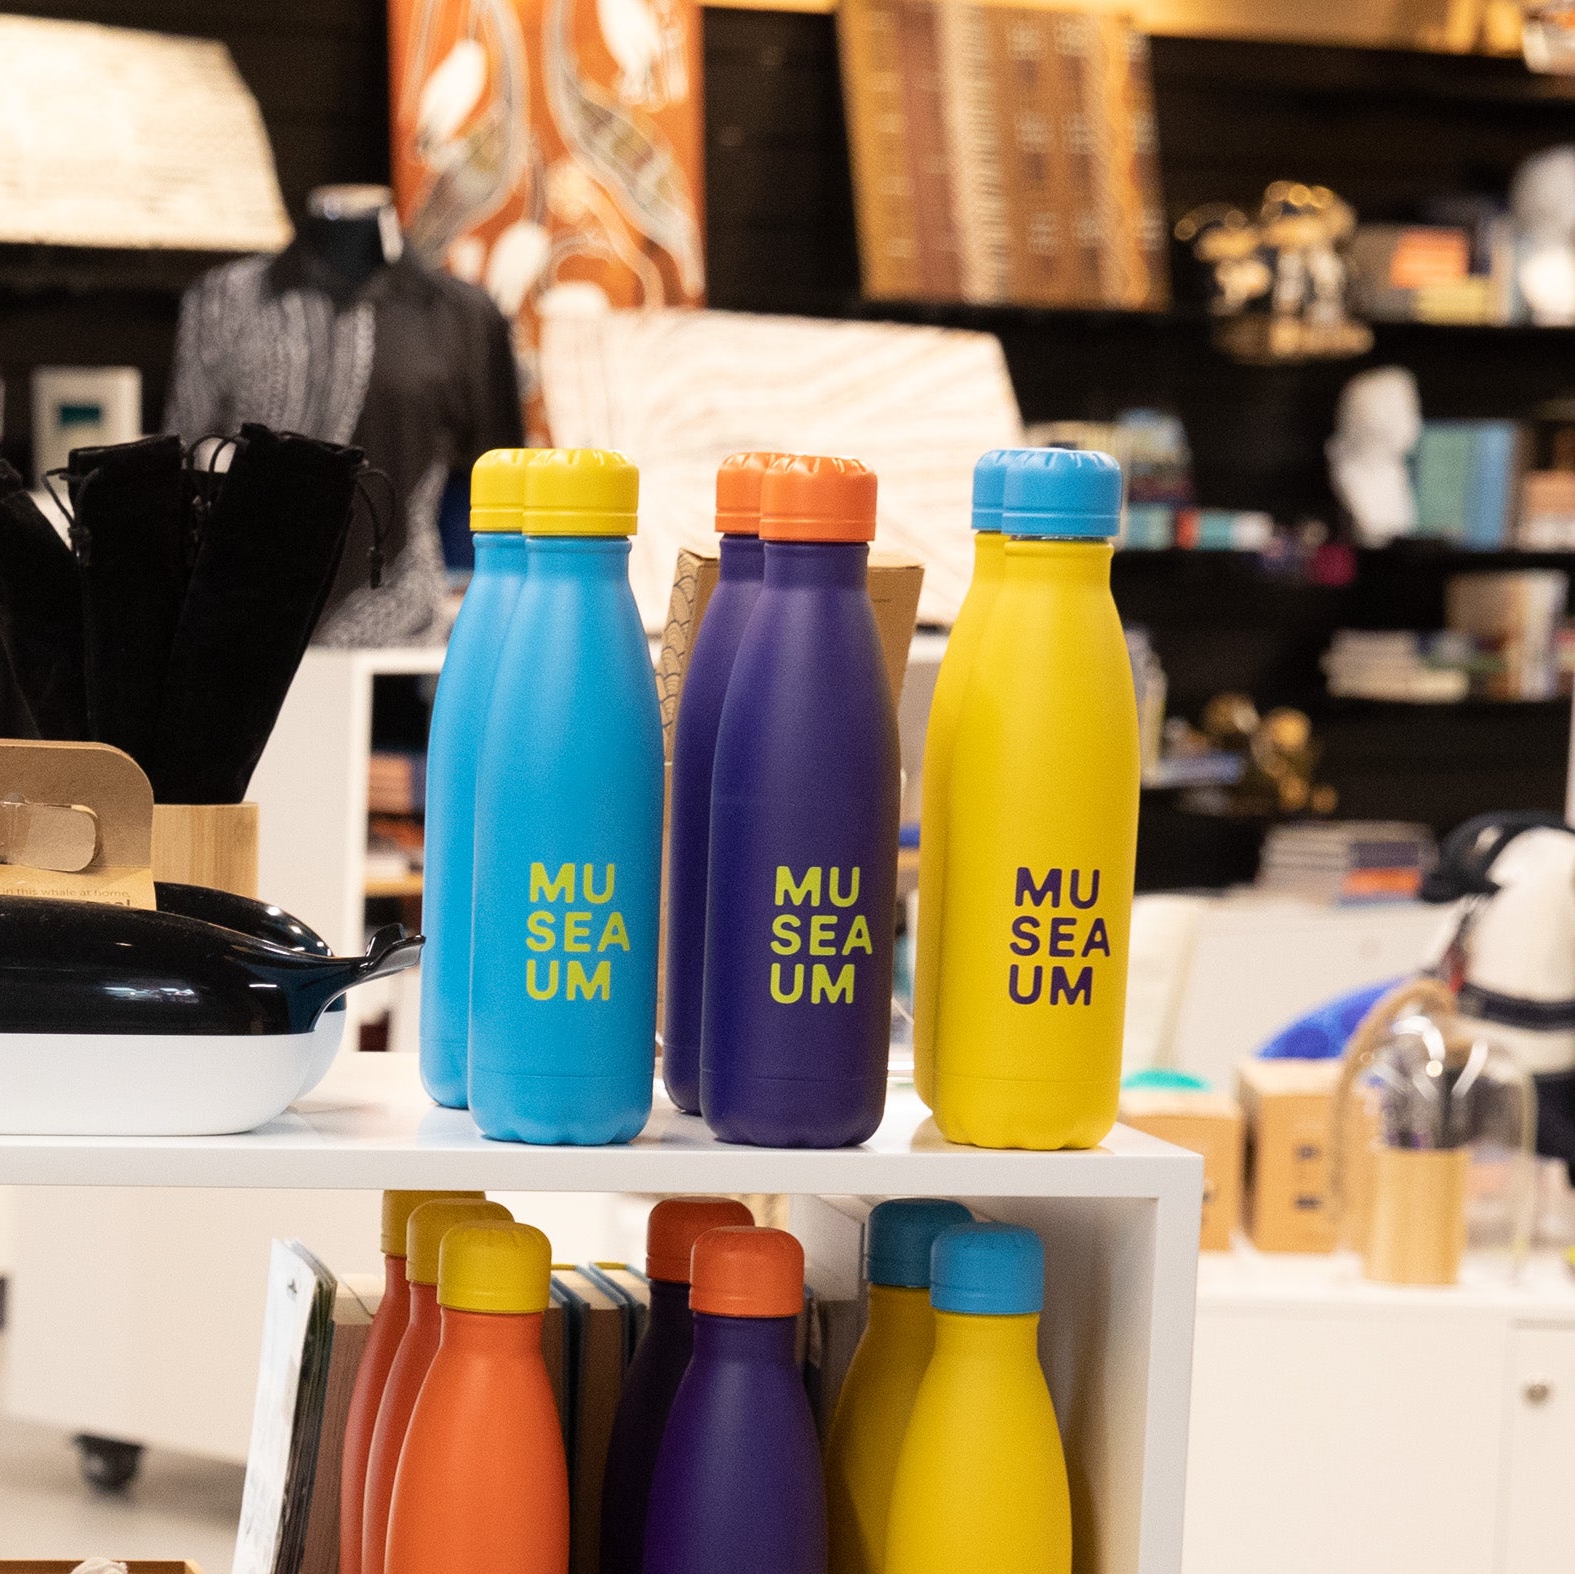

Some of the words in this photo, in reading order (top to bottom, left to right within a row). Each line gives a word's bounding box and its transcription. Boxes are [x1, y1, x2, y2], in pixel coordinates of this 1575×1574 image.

[529, 862, 616, 904] MU
[775, 865, 860, 907] MU
[1015, 867, 1100, 908] MU
[525, 911, 631, 953] SEA
[771, 914, 873, 957] SEA
[1010, 915, 1111, 958] SEA
[525, 959, 611, 1001] UM
[771, 962, 855, 1005] UM
[1008, 964, 1092, 1007] UM
